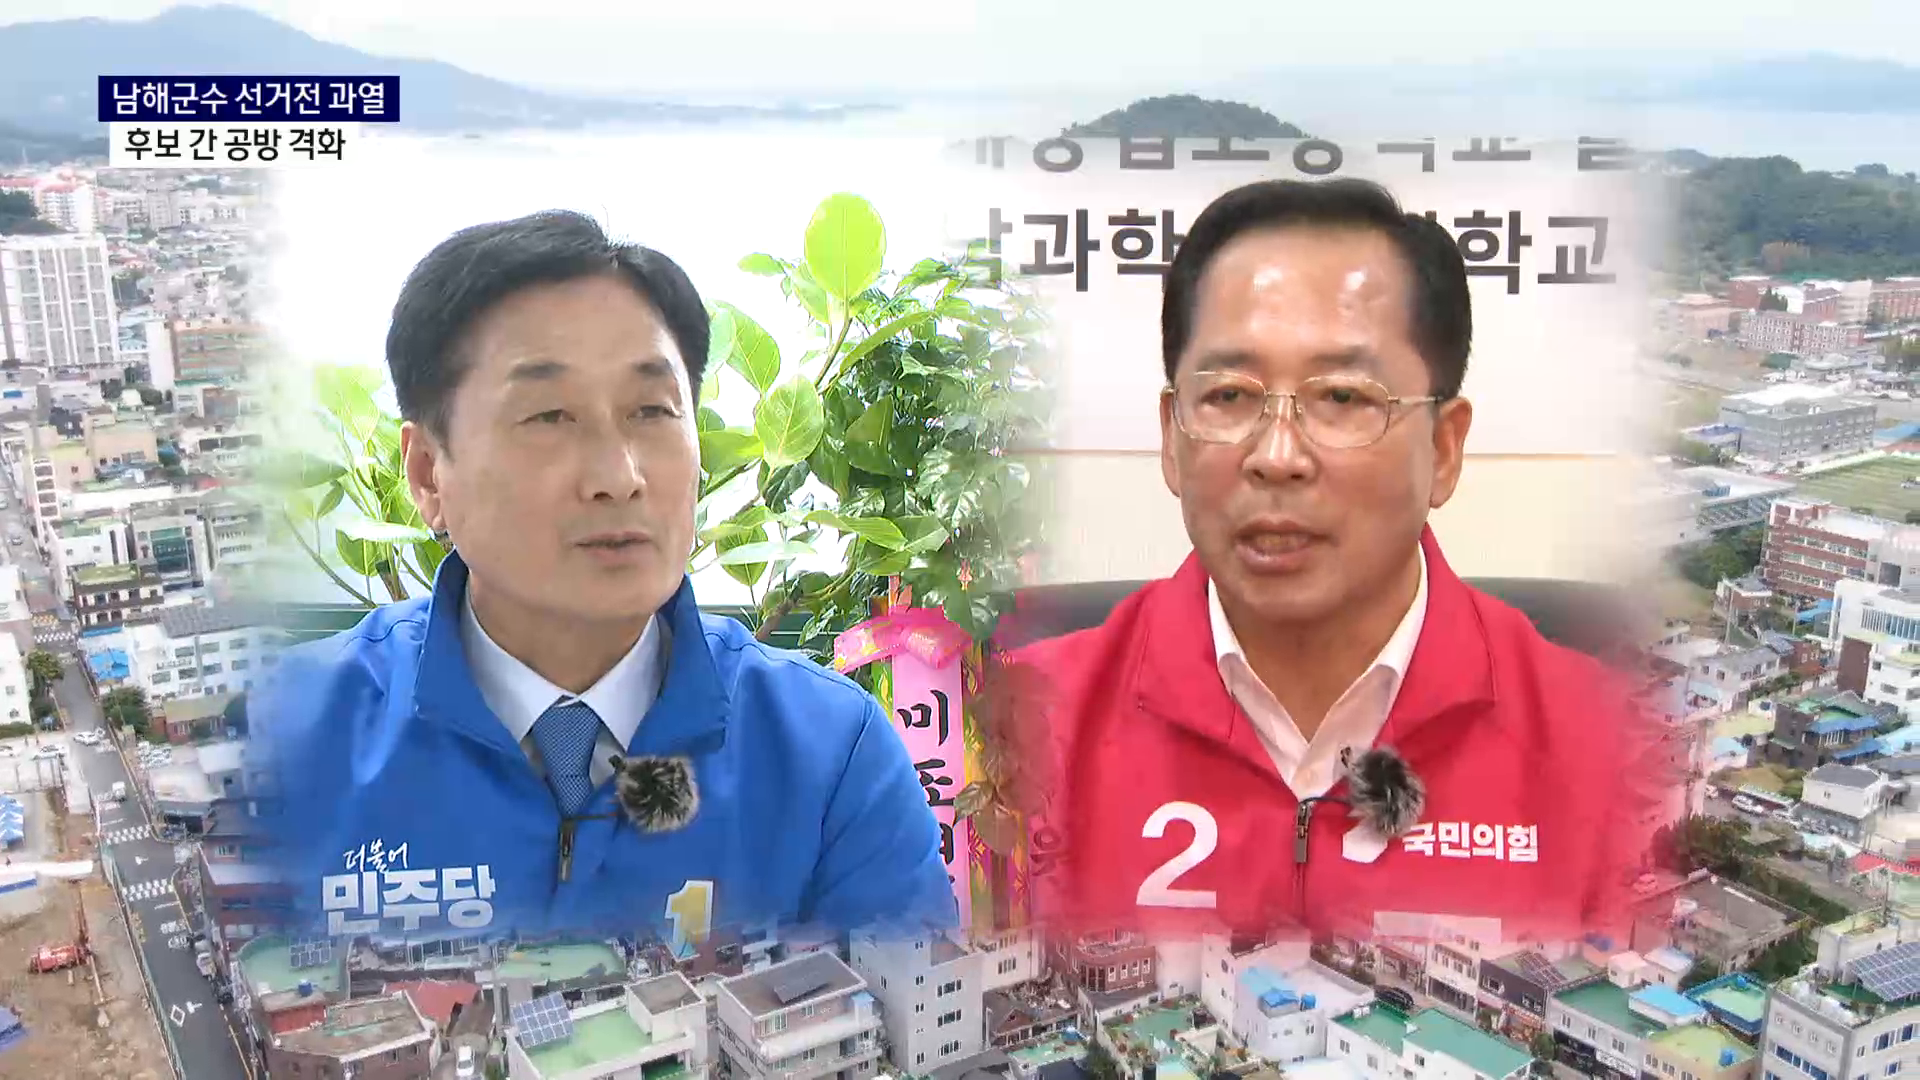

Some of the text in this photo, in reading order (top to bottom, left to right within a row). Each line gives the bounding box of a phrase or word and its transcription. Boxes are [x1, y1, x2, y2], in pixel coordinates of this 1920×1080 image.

[343, 838, 409, 873] 더불어
[1135, 800, 1218, 909] 2
[1402, 821, 1538, 862] 국민의힘
[322, 865, 496, 935] 민주당
[664, 879, 714, 945] 1
